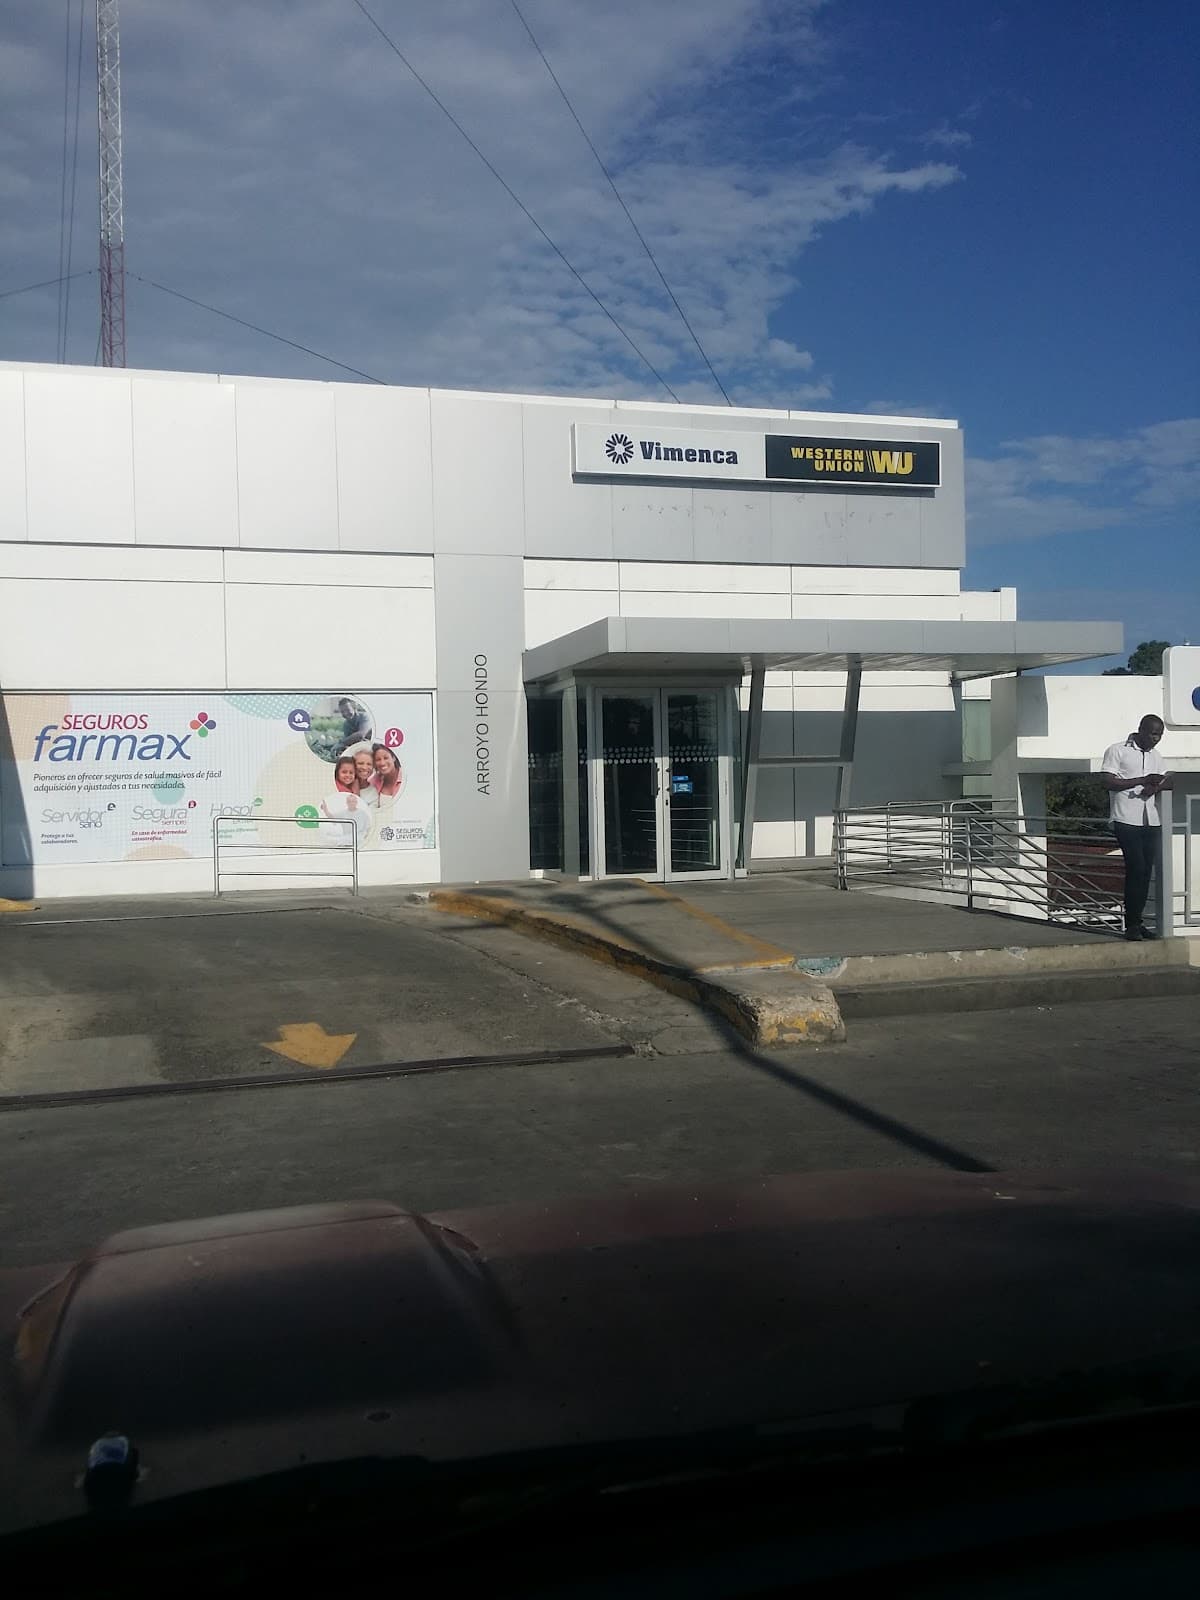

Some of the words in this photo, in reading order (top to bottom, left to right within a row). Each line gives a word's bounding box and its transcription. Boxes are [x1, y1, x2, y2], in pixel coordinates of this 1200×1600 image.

[639, 440, 739, 465] Vimenca
[790, 446, 864, 461] WESTERN
[813, 459, 865, 473] UNION
[871, 450, 914, 475] WU
[474, 654, 489, 717] HONDO
[61, 714, 149, 730] SEGUROS
[33, 725, 192, 762] farmax
[475, 723, 491, 796] ARROYO
[33, 773, 66, 782] Pioneros
[77, 773, 104, 784] ofrecer
[104, 773, 132, 783] seguros
[133, 772, 143, 781] de
[144, 771, 165, 780] salud
[165, 771, 195, 779] masivos
[195, 771, 205, 779] de
[205, 770, 222, 780] fácil
[33, 783, 77, 793] adquisición
[77, 785, 82, 793] y
[83, 783, 120, 793] ajustados
[40, 807, 106, 824] Servidor
[131, 805, 188, 823] Segura
[79, 820, 103, 829] sano
